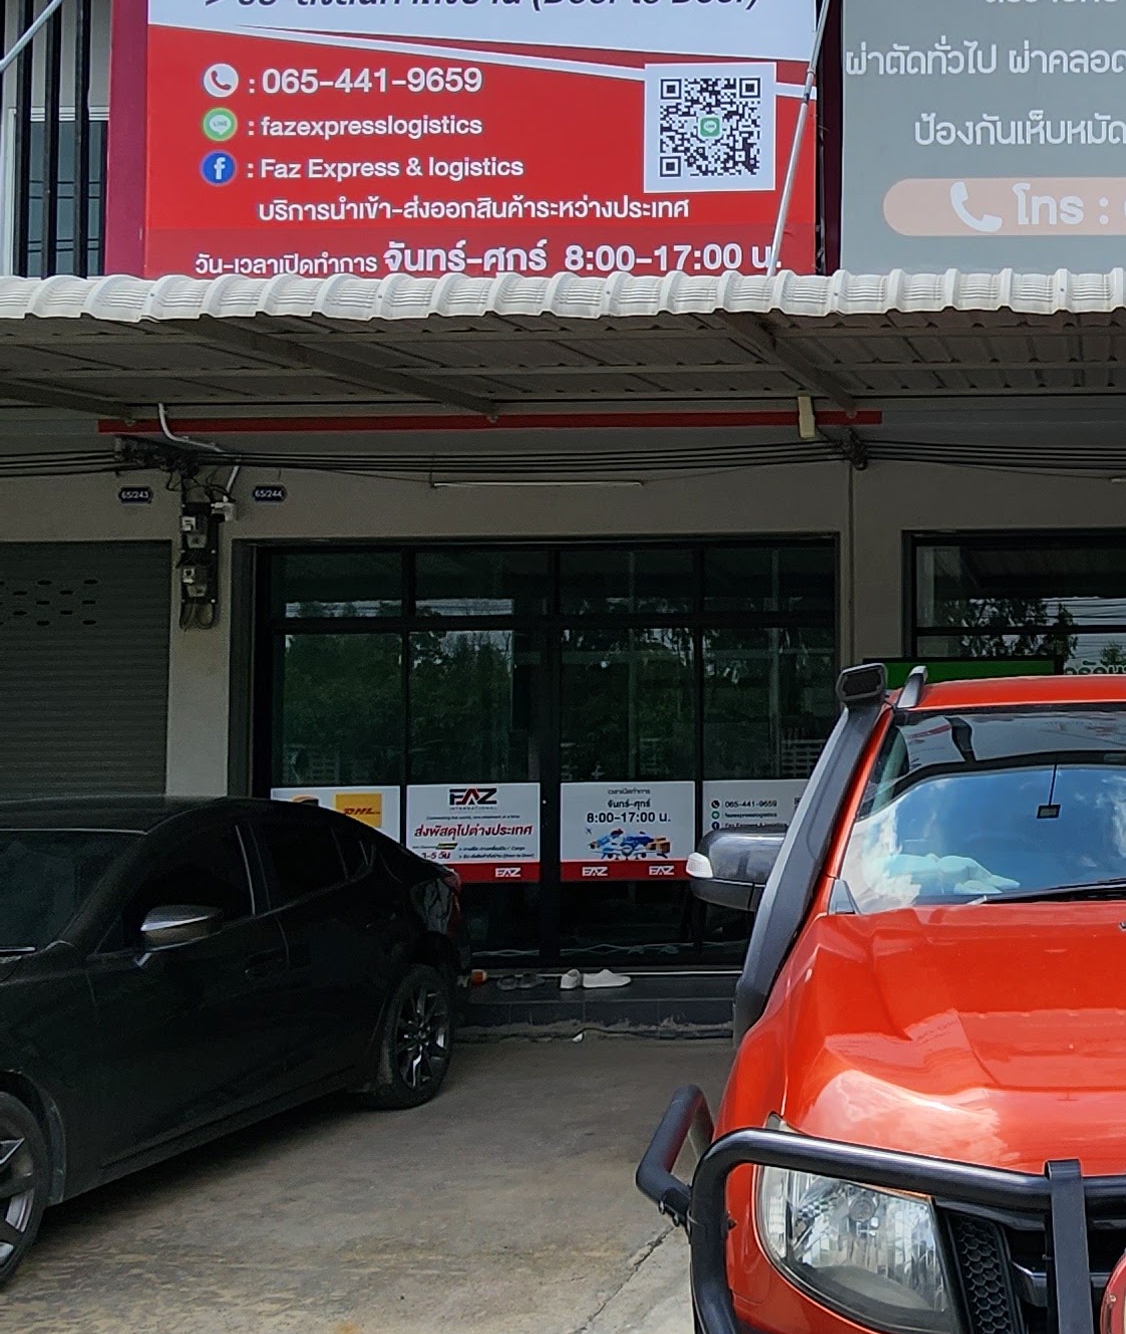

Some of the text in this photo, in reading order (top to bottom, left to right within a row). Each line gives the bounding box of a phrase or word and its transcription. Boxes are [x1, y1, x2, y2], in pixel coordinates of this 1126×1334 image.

[845, 36, 996, 75] ผ่าตัดทั่วไป
[262, 67, 482, 93] 065-441-9659
[261, 115, 482, 140] fazexpresslogistics
[915, 110, 1126, 145] ป้องกันเห็บหมัด
[261, 159, 301, 178] Faz
[308, 159, 400, 182] Express
[406, 157, 423, 176] &
[429, 157, 523, 181] logistics
[1013, 183, 1084, 224] โทร
[565, 243, 743, 272] 8:00-17:00
[448, 787, 498, 806] FAZ
[586, 812, 671, 824] 8:00-17:00 น.
